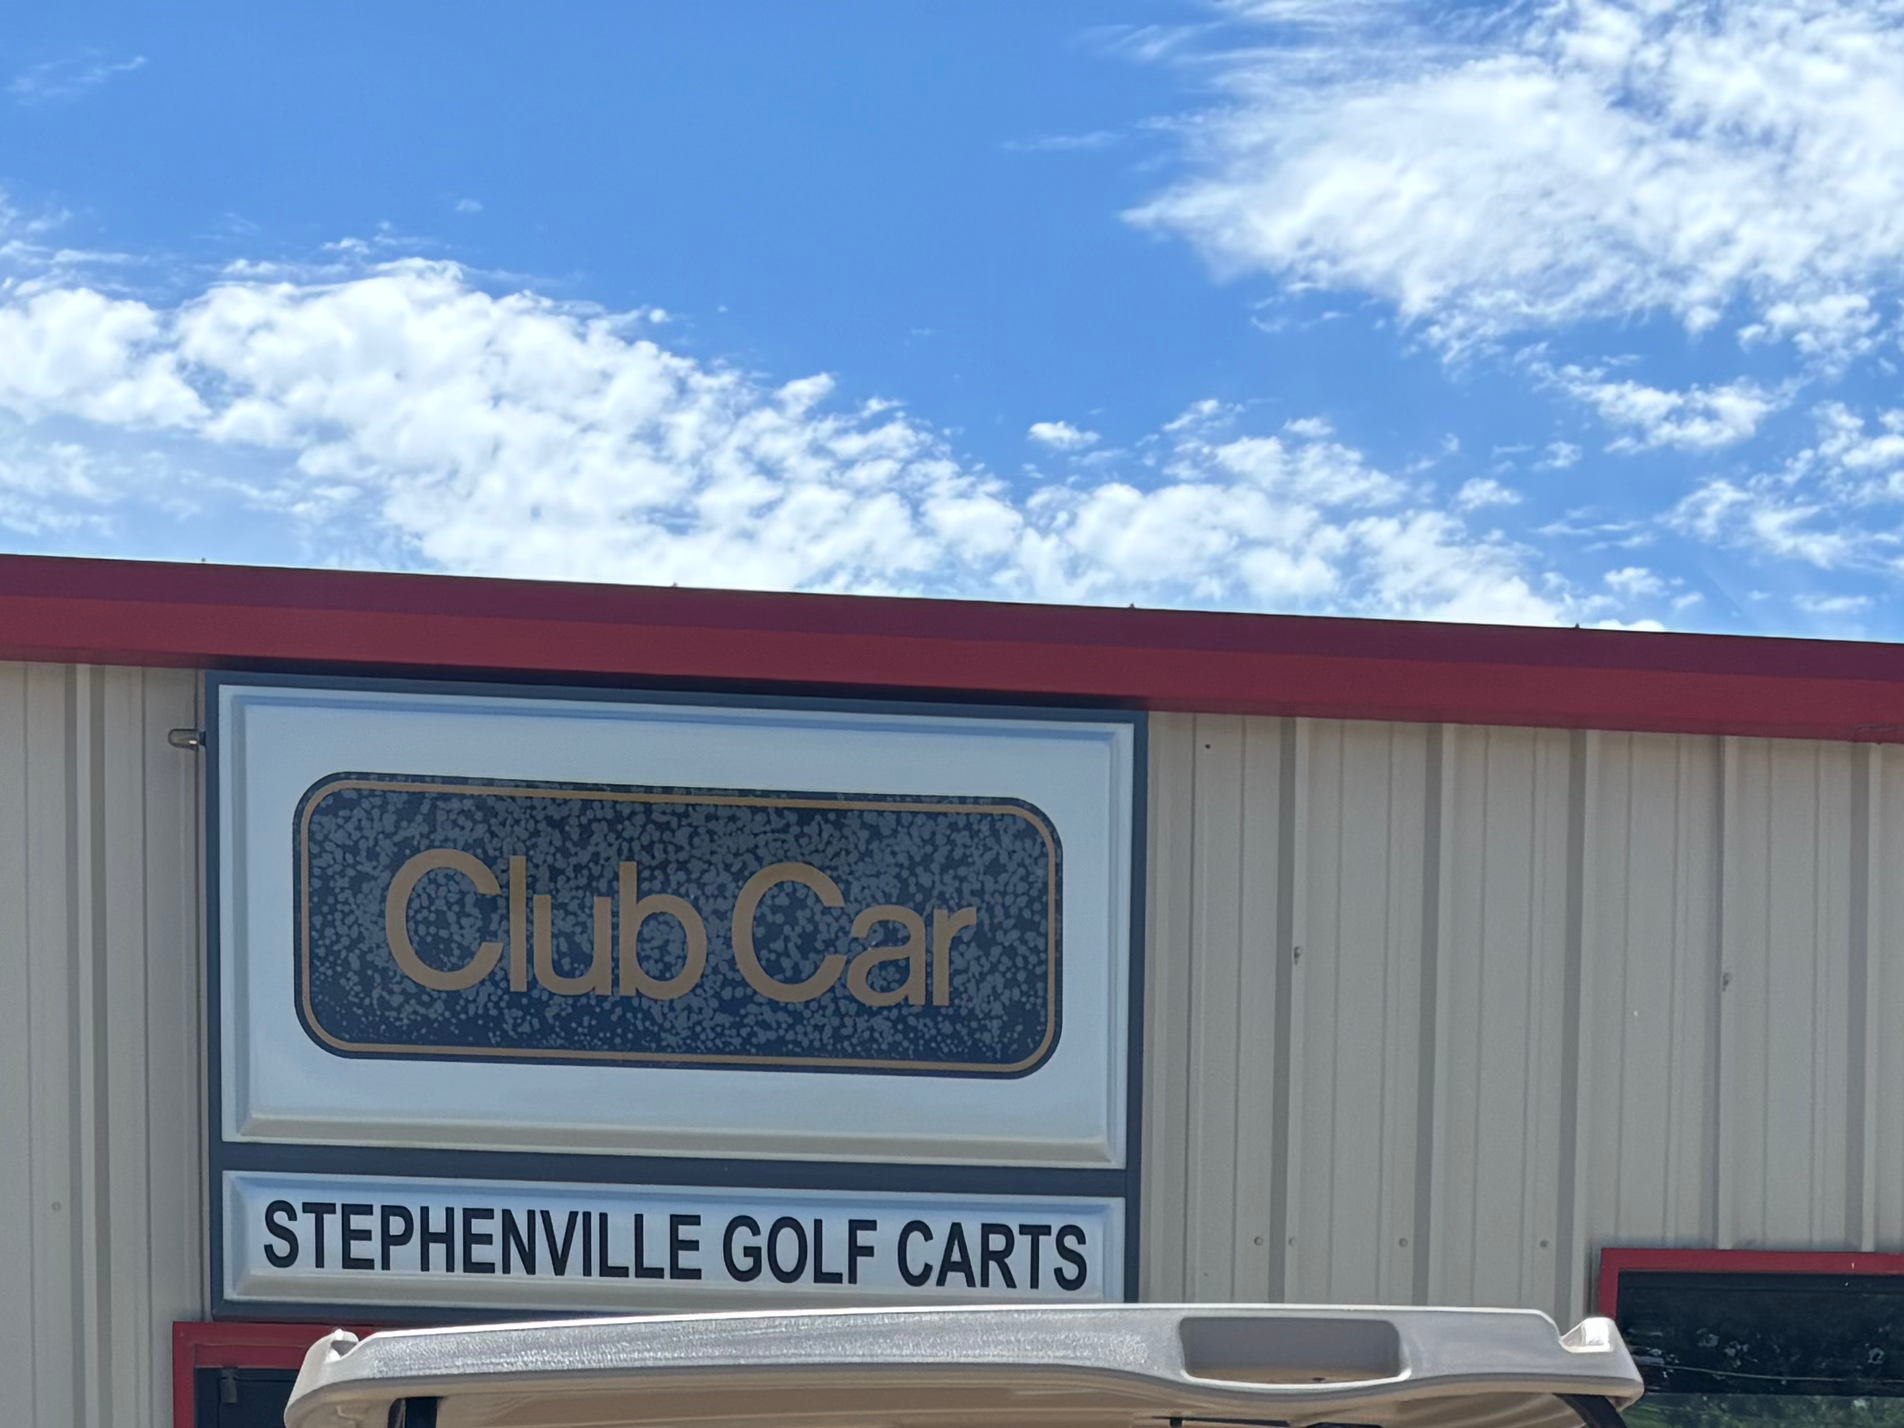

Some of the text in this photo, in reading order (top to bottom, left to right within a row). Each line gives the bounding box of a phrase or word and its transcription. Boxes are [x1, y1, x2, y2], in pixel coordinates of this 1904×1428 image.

[383, 848, 978, 1009] Club Car
[262, 1199, 1089, 1293] STEPHENVILLE GOLF CARTS
